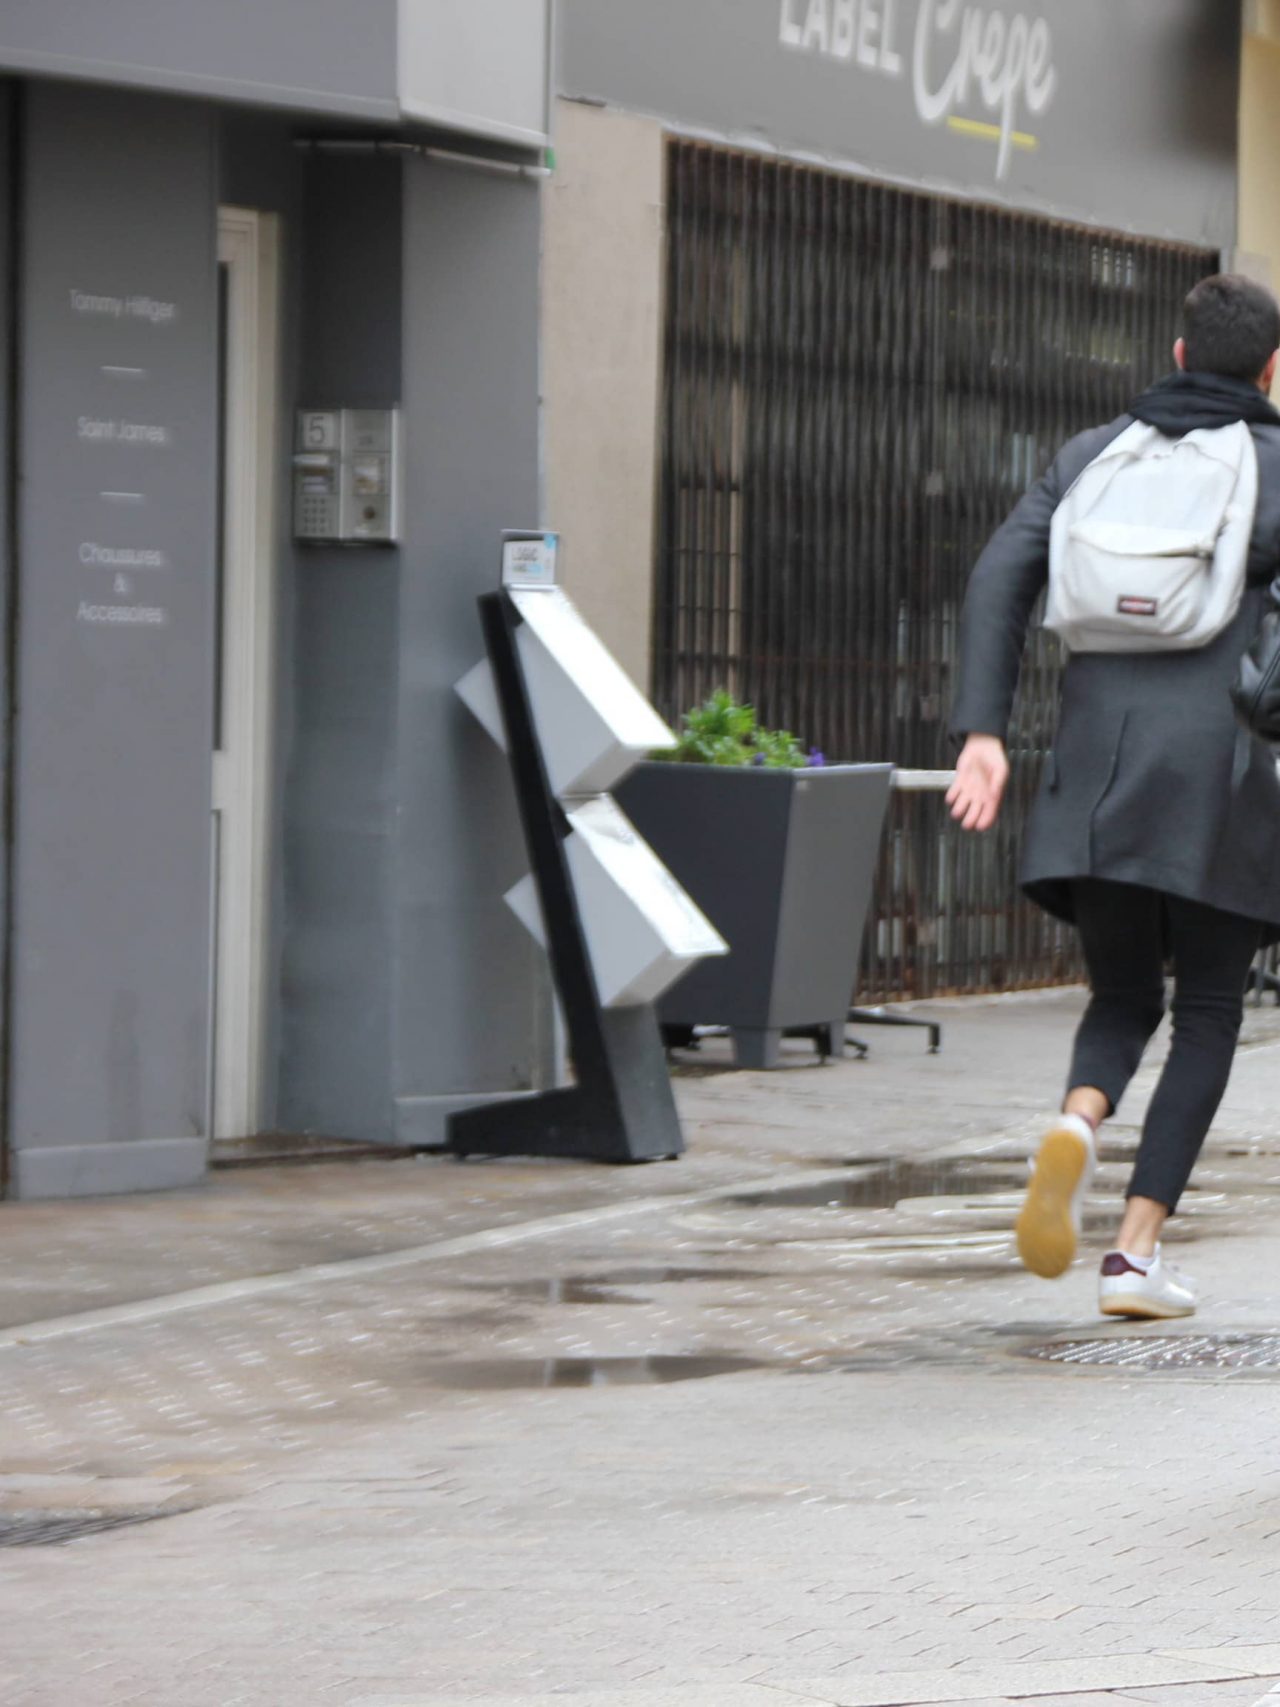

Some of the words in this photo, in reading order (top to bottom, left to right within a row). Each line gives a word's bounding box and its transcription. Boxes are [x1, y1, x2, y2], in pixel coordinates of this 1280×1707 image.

[69, 288, 122, 318] Tommy
[126, 296, 177, 322] Hilfiger
[77, 416, 115, 439] Saint
[118, 419, 167, 444] James
[308, 415, 326, 444] 5
[78, 542, 163, 567] Chaussures
[77, 601, 164, 624] Accessoires
